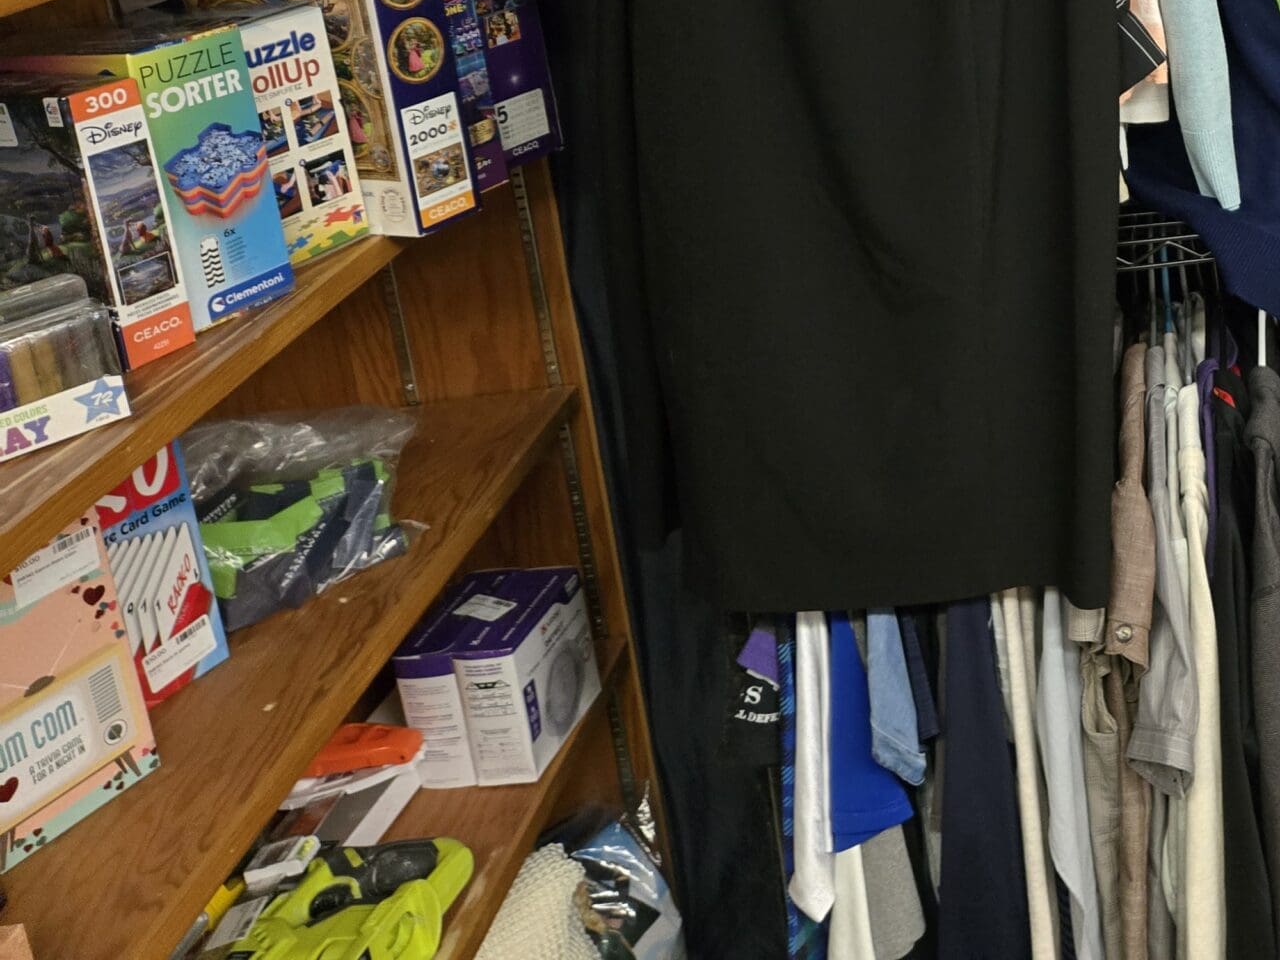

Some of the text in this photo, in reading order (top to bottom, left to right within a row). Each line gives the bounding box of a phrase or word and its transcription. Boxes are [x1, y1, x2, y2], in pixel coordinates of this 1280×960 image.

[139, 41, 236, 89] PUZZLE
[245, 30, 316, 68] uzzle
[252, 57, 320, 94] ollUp
[85, 88, 127, 113] 300
[145, 68, 244, 119] SORTER
[406, 104, 452, 126] Disney
[497, 105, 508, 124] 5
[80, 122, 142, 145] Disney
[409, 123, 448, 147] 2000
[223, 227, 236, 238] 6x
[225, 272, 285, 305] Clementoni
[13, 404, 48, 422] COLORS
[91, 391, 113, 407] 72
[0, 415, 50, 456] AY
[120, 511, 150, 535] Card
[152, 493, 187, 517] Game
[740, 685, 763, 704] S
[30, 700, 78, 750] COM
[29, 735, 83, 776] A TRIVIA GAME
[31, 743, 86, 785] FOR A NIGHT IN
